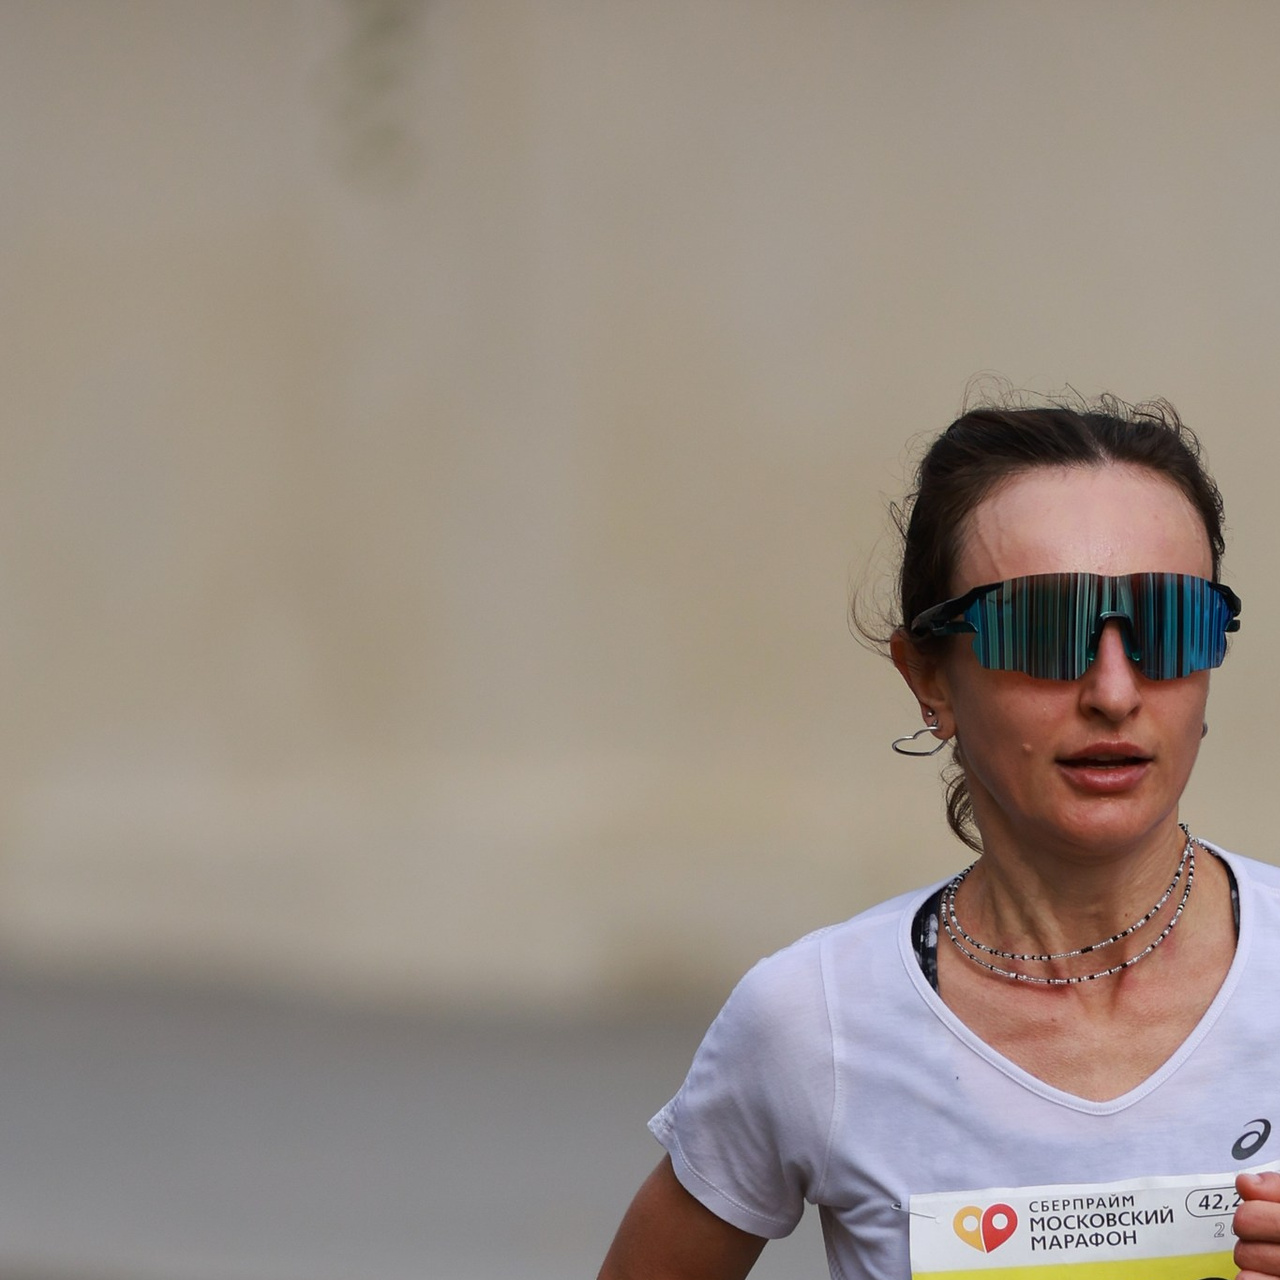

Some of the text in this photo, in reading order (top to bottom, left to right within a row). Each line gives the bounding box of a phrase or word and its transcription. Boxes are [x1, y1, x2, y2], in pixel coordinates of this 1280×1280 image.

[1029, 1194, 1135, 1213] СБЕРПРАЙМ
[1029, 1206, 1175, 1232] МОСКОВСКИЙ
[1214, 1221, 1236, 1239] 2
[1030, 1230, 1138, 1251] МАРАФОН
